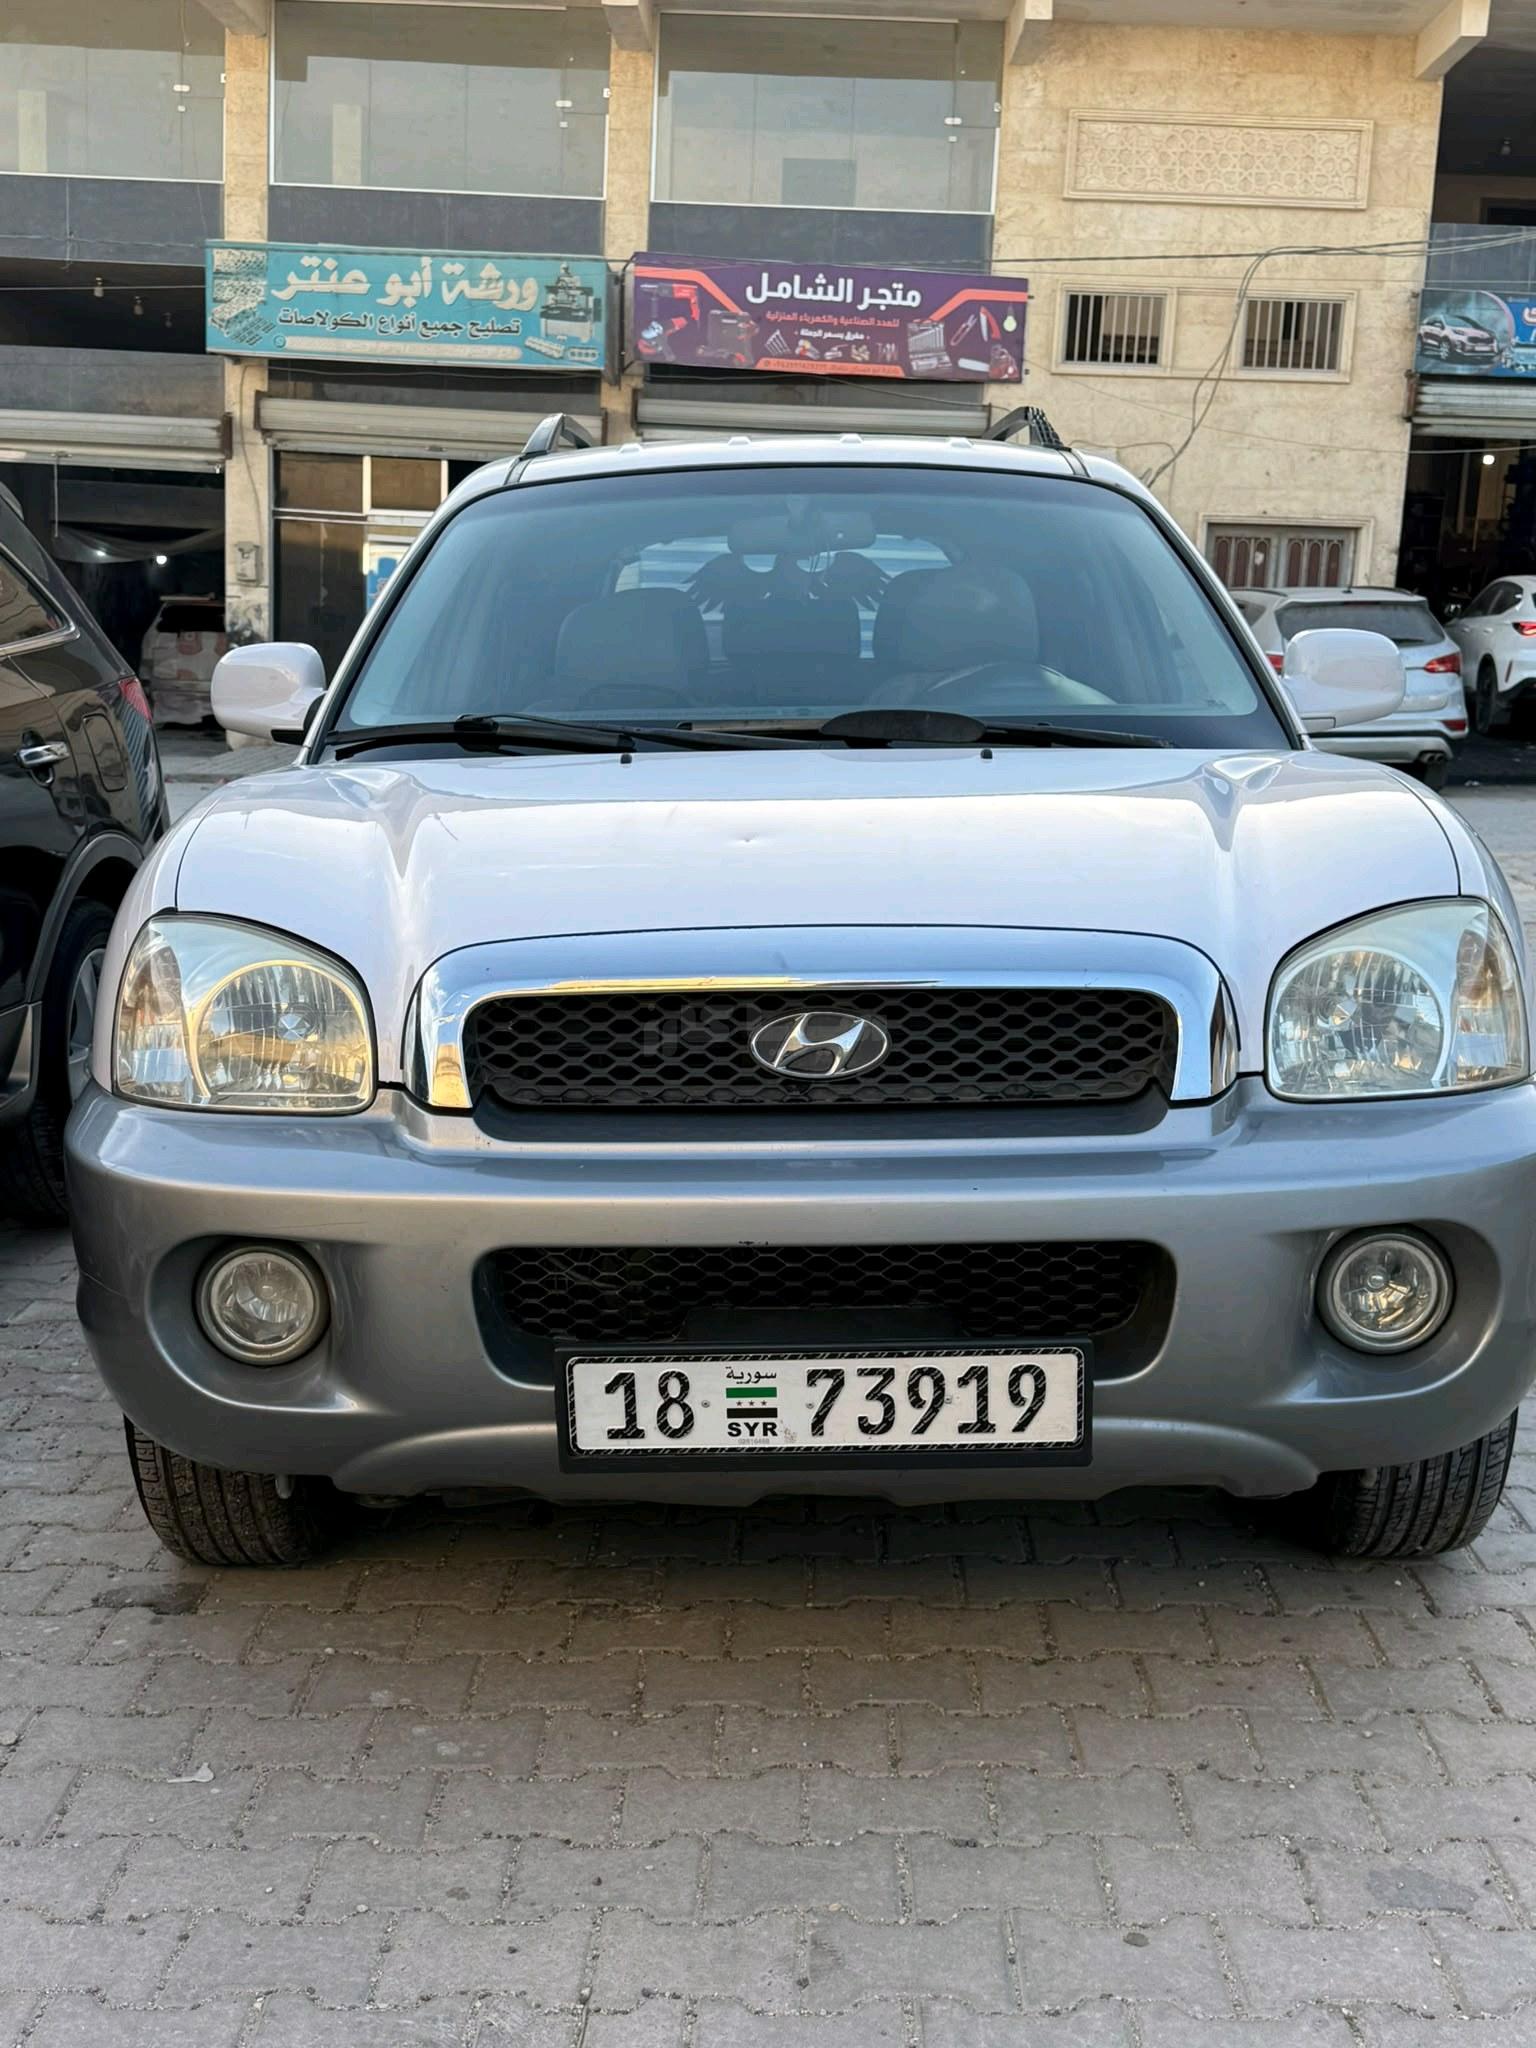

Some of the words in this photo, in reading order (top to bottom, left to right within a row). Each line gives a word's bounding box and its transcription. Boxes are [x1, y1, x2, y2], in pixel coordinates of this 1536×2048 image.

[271, 255, 371, 300] عنتر
[376, 256, 433, 308] أبو
[442, 262, 538, 311] ورشة
[746, 272, 854, 304] الشامل
[857, 283, 921, 311] متجر
[377, 313, 416, 335] أنواع
[420, 320, 463, 338] جميع
[468, 319, 521, 339] تصليح
[725, 1367, 777, 1386] سورية
[604, 1370, 696, 1439] 18
[806, 1364, 1048, 1438] 73919
[727, 1421, 778, 1437] SYR
